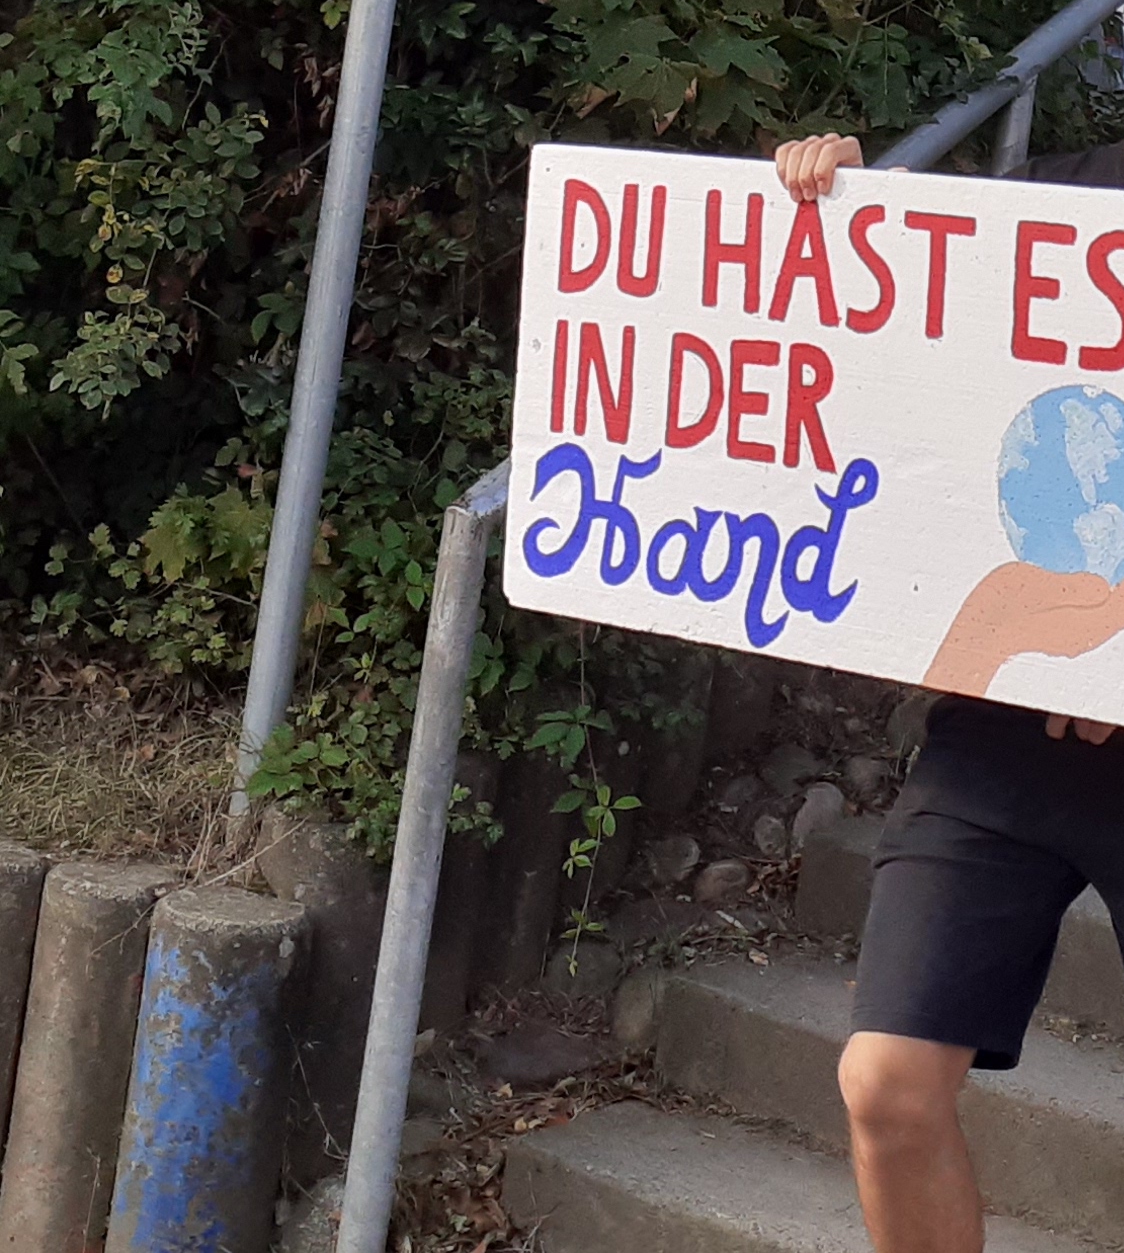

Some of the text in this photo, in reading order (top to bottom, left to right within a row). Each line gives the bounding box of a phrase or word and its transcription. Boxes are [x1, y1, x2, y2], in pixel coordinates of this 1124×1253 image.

[558, 178, 668, 297] DU
[703, 190, 977, 339] HAST
[550, 319, 837, 473] IN DER
[523, 442, 880, 649] Hand
